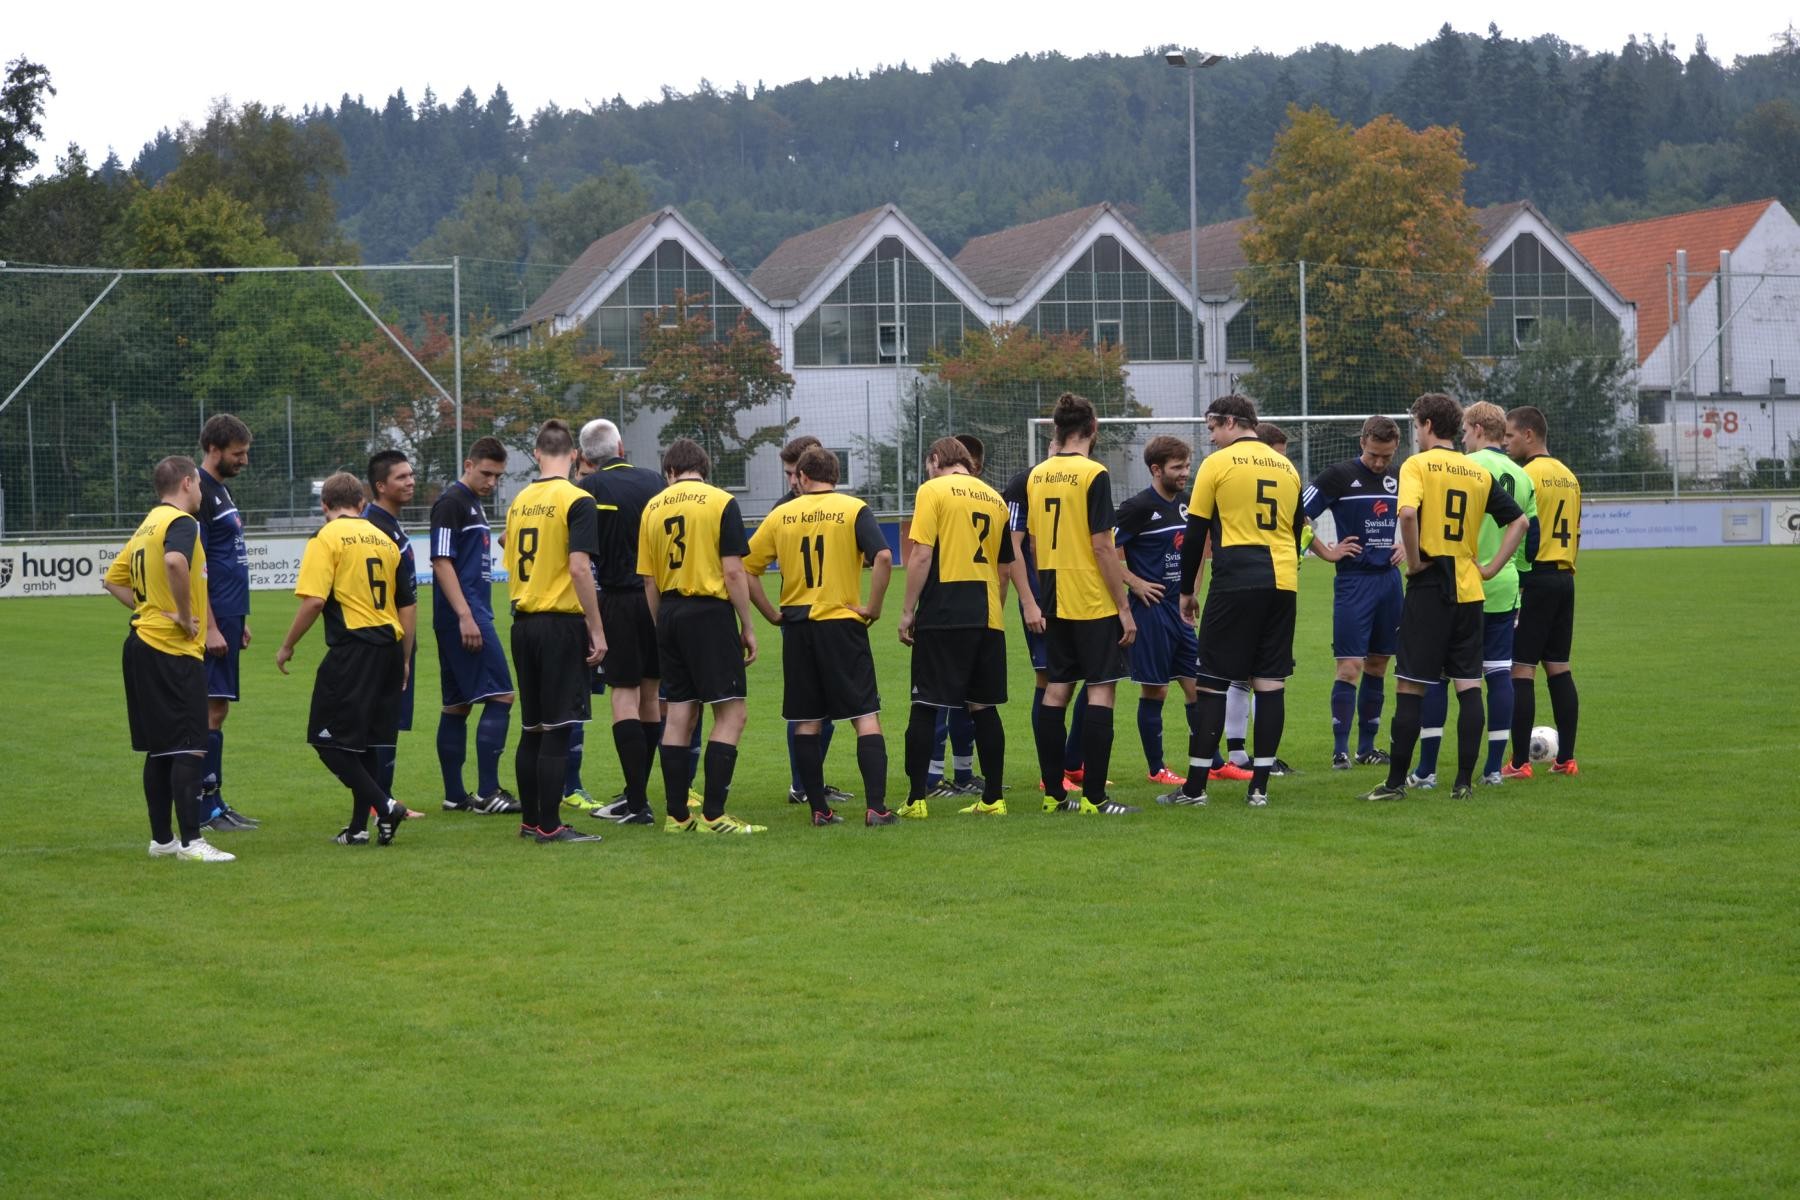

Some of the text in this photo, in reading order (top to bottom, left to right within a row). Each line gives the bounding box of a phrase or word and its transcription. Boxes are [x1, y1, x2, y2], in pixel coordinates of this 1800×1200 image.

[1232, 456, 1293, 475] tsv keilberg
[1427, 462, 1484, 483] tsv keilberg
[951, 486, 967, 497] tsv
[1045, 472, 1078, 486] keilberg
[649, 491, 707, 511] tsv keilberg
[1256, 479, 1278, 531] 5
[782, 509, 845, 525] tsv keilberg
[1045, 497, 1061, 550] 7
[1444, 489, 1468, 542] 9
[1552, 499, 1571, 549] 4
[664, 515, 686, 570] 3
[972, 511, 991, 564] 2
[247, 545, 268, 556] erei
[518, 527, 538, 582] 8
[800, 534, 824, 589] 11
[22, 552, 93, 582] hugo
[249, 559, 289, 570] enbach
[23, 581, 56, 593] gmbh
[250, 574, 270, 585] Fax
[366, 557, 387, 610] 6
